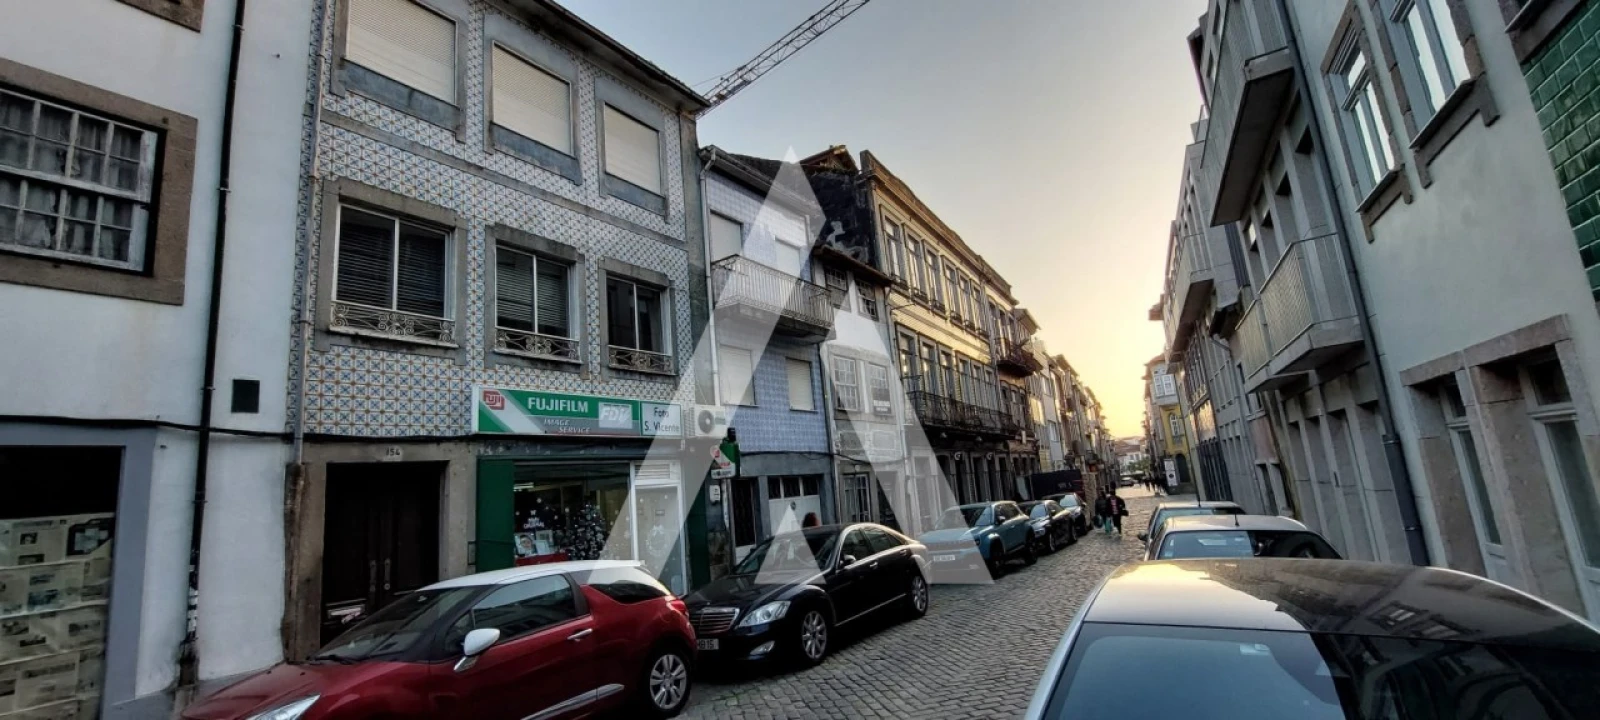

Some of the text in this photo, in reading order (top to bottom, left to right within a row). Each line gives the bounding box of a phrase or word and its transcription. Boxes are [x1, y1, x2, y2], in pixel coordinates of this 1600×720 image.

[527, 397, 589, 413] FUJIFILM
[653, 407, 670, 417] Foto
[543, 418, 571, 427] IMAGE
[653, 421, 680, 432] Vicente
[558, 426, 591, 434] SERVICE
